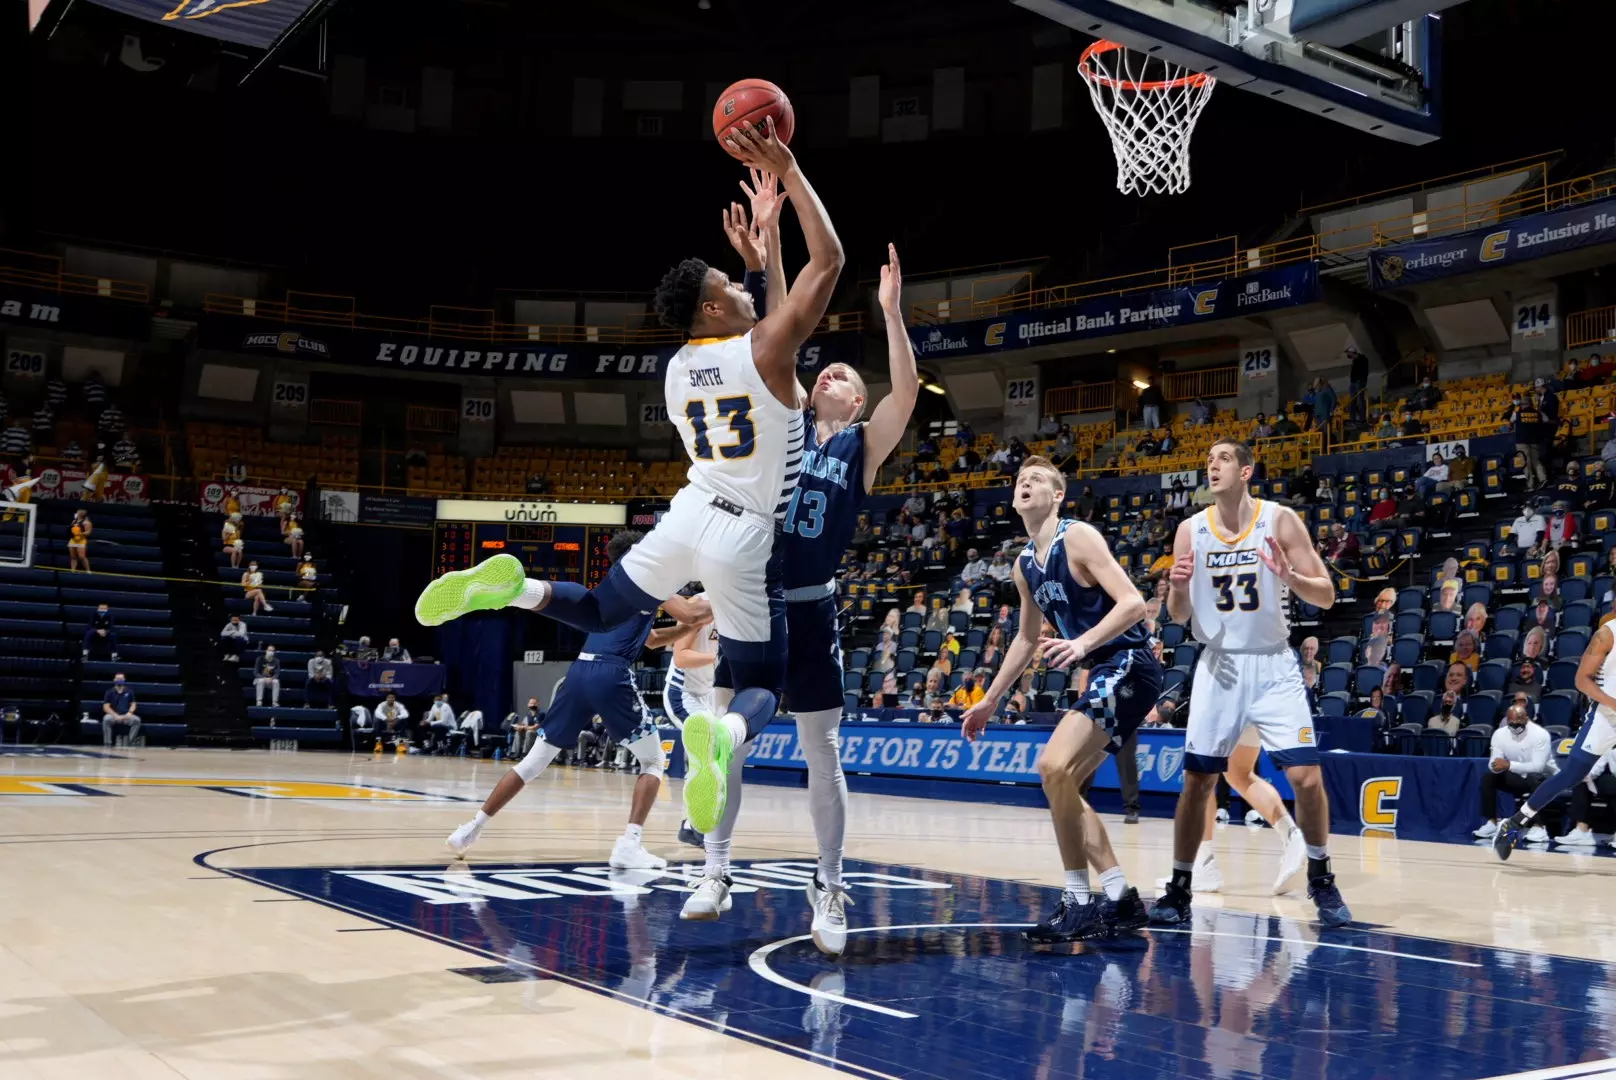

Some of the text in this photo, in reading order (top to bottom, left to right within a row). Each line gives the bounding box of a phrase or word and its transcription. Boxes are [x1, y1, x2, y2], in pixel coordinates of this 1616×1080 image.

[1517, 216, 1590, 249] Exclusive
[1405, 247, 1467, 270] erlanger
[1236, 285, 1291, 307] FirstBank
[1018, 302, 1182, 341] Official Bank Partner
[1518, 303, 1550, 330] 214
[246, 335, 278, 345] MOCS
[298, 338, 328, 353] CLUB
[921, 335, 968, 353] FirstBank
[9, 352, 42, 373] 208
[376, 342, 659, 374] EQUIPPING FOR
[1245, 349, 1271, 371] 213
[689, 366, 723, 388] SMITH
[276, 383, 305, 402] 209
[1009, 380, 1035, 399] 212
[465, 400, 493, 418] 210
[644, 405, 668, 422] 210
[684, 393, 757, 462] 13
[505, 503, 557, 521] unum
[631, 514, 656, 525] FOOD
[783, 485, 828, 539] 13
[1207, 549, 1258, 567] MOCS
[1212, 573, 1259, 612] 33
[525, 651, 542, 663] 112
[862, 736, 923, 769] FOR
[925, 738, 963, 770] 75
